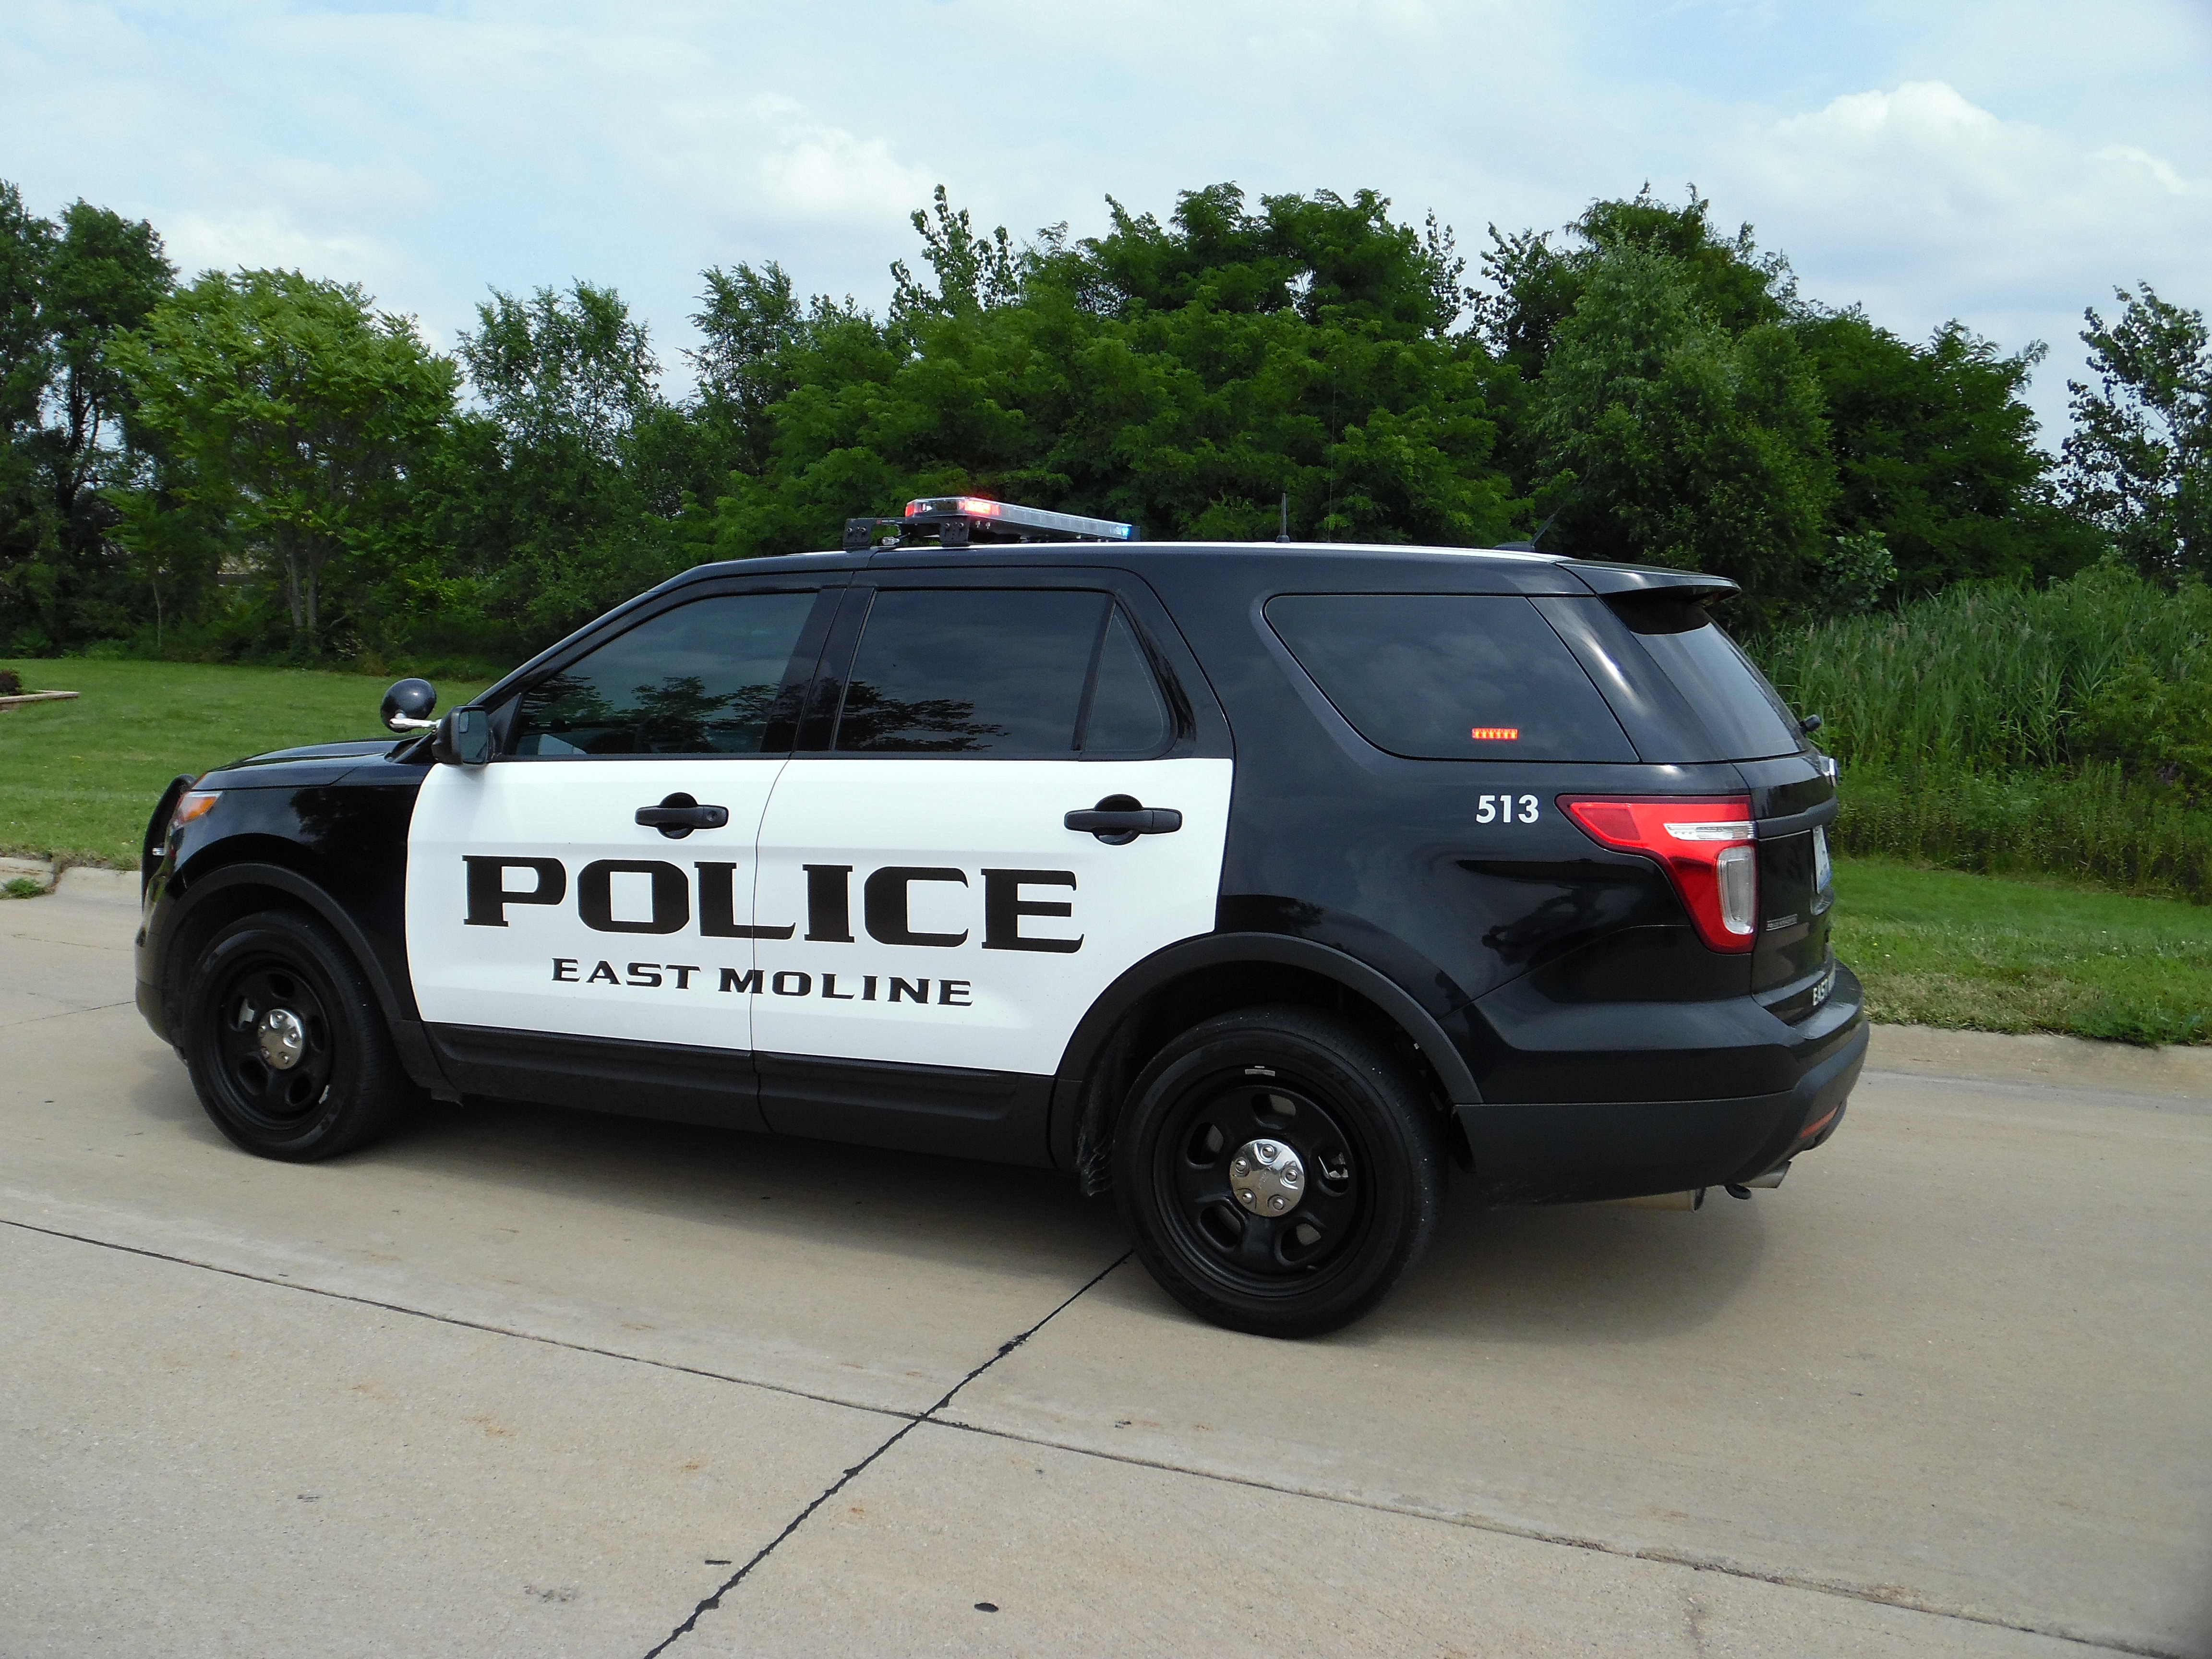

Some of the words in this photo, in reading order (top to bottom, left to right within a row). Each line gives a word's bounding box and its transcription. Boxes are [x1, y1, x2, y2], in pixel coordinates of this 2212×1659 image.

[1476, 794, 1539, 823] 513
[461, 854, 1085, 954] POLICE
[552, 958, 701, 989] EAST
[718, 967, 973, 1007] MOLINE
